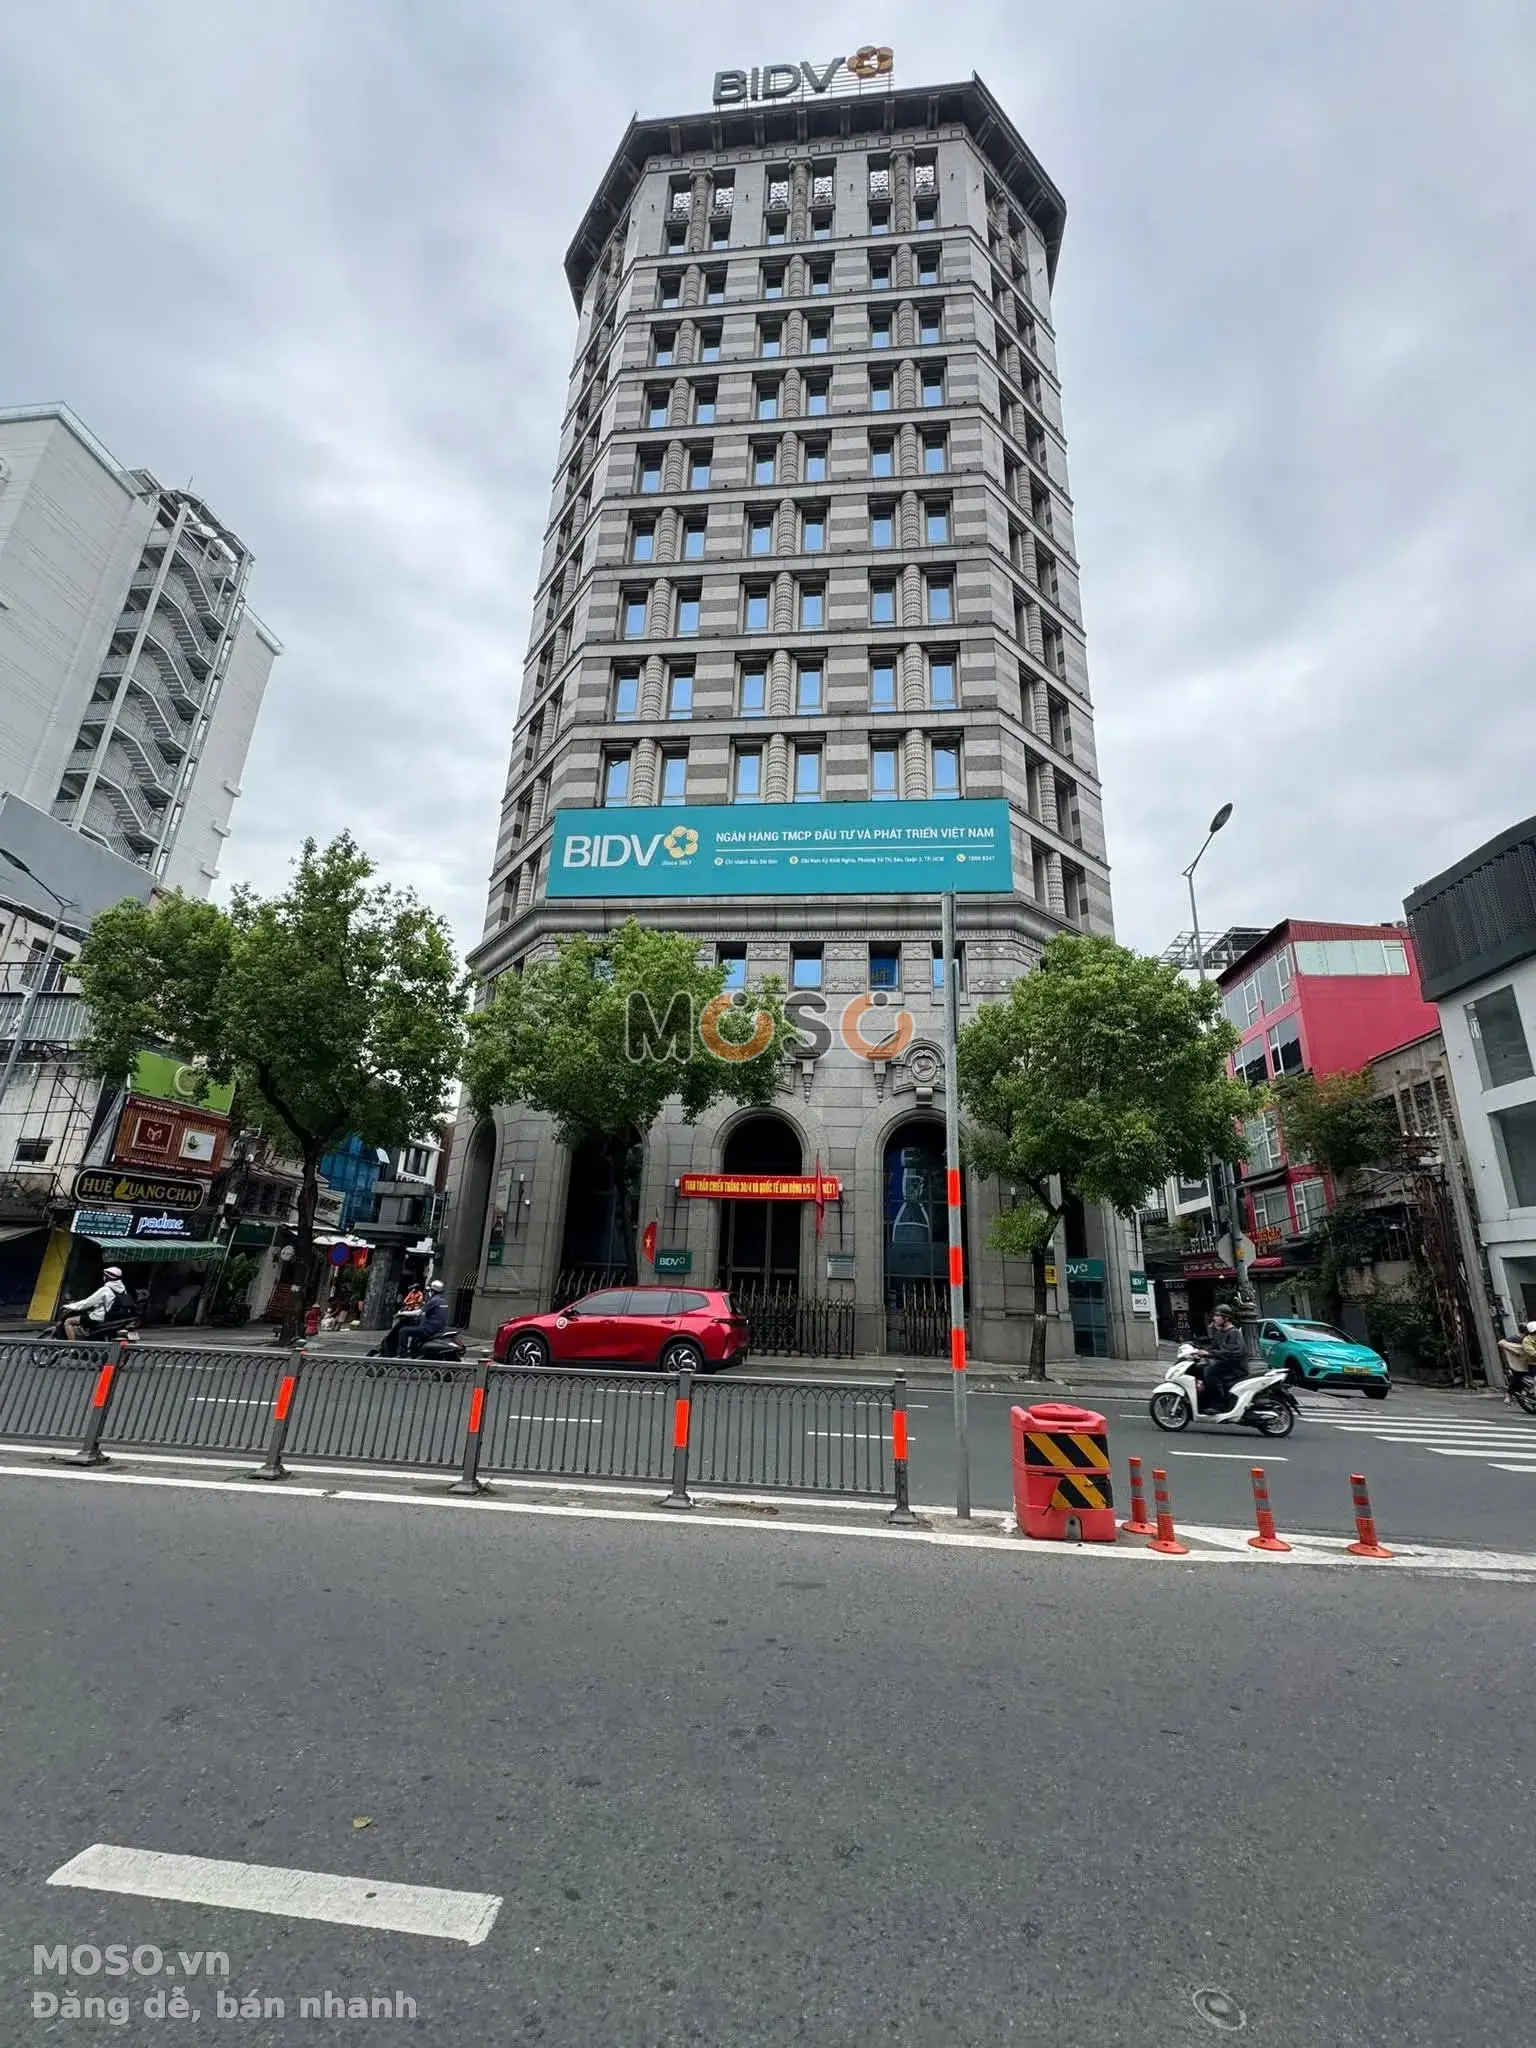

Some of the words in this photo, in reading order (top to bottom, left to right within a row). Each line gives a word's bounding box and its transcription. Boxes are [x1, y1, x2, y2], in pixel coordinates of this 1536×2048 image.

[713, 57, 846, 105] BIDV
[715, 830, 746, 842] NGÂN
[781, 830, 812, 841] TMCP
[873, 827, 903, 839] PHÁT
[940, 826, 966, 839] VIỆT
[968, 827, 994, 838] NAM
[563, 834, 665, 867] BIDV
[166, 1187, 201, 1203] CHAY
